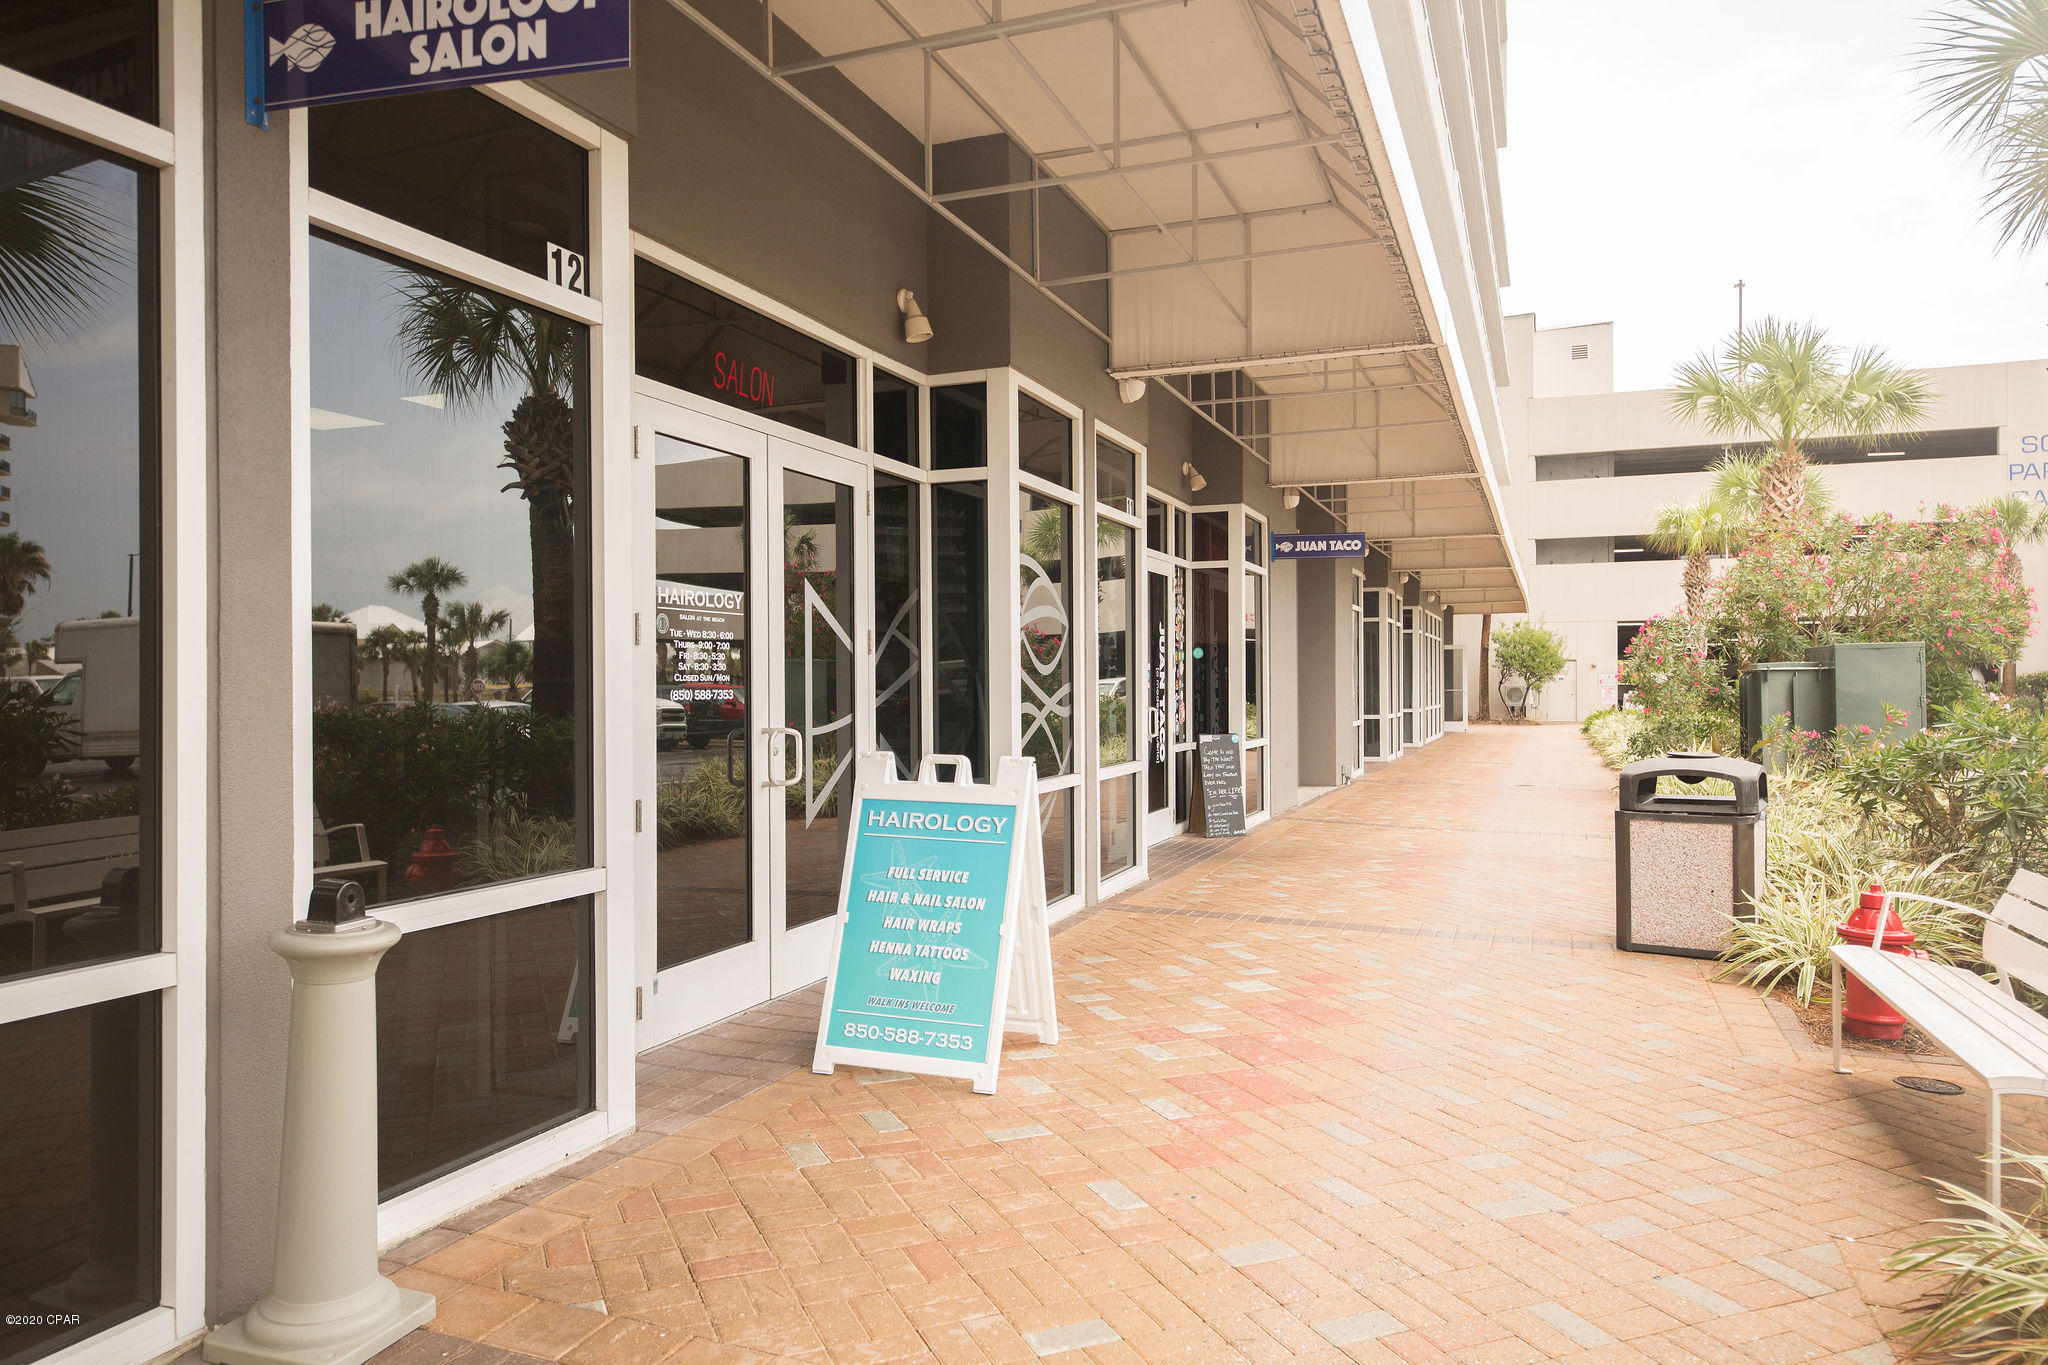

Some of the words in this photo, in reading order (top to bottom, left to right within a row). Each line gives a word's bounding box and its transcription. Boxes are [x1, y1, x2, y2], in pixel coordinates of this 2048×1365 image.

[355, 0, 596, 40] HAIROL
[409, 18, 548, 76] SALON
[551, 247, 583, 293] 12
[714, 352, 775, 407] SALON
[1294, 540, 1327, 552] JUAN
[1329, 539, 1362, 551] TACO
[657, 587, 744, 609] HAIROLOGY
[670, 688, 693, 702] (850)
[694, 689, 734, 700] 588-7353
[866, 810, 1008, 835] HAIROLOGY
[886, 866, 917, 880] FULL
[918, 868, 970, 884] SERVICE
[866, 889, 899, 904] HAIR
[900, 892, 911, 905] &
[912, 893, 942, 908] NAIL
[943, 895, 987, 911] SALON
[882, 916, 915, 932] HAIR
[916, 918, 963, 934] WRAPS
[868, 940, 912, 956] HENNA
[913, 944, 970, 961] TATTOOS
[888, 967, 942, 985] WAXING
[867, 995, 894, 1007] WALK
[893, 998, 911, 1010] INS
[911, 1001, 957, 1015] WELCOME
[843, 1022, 973, 1051] 850-588-7353
